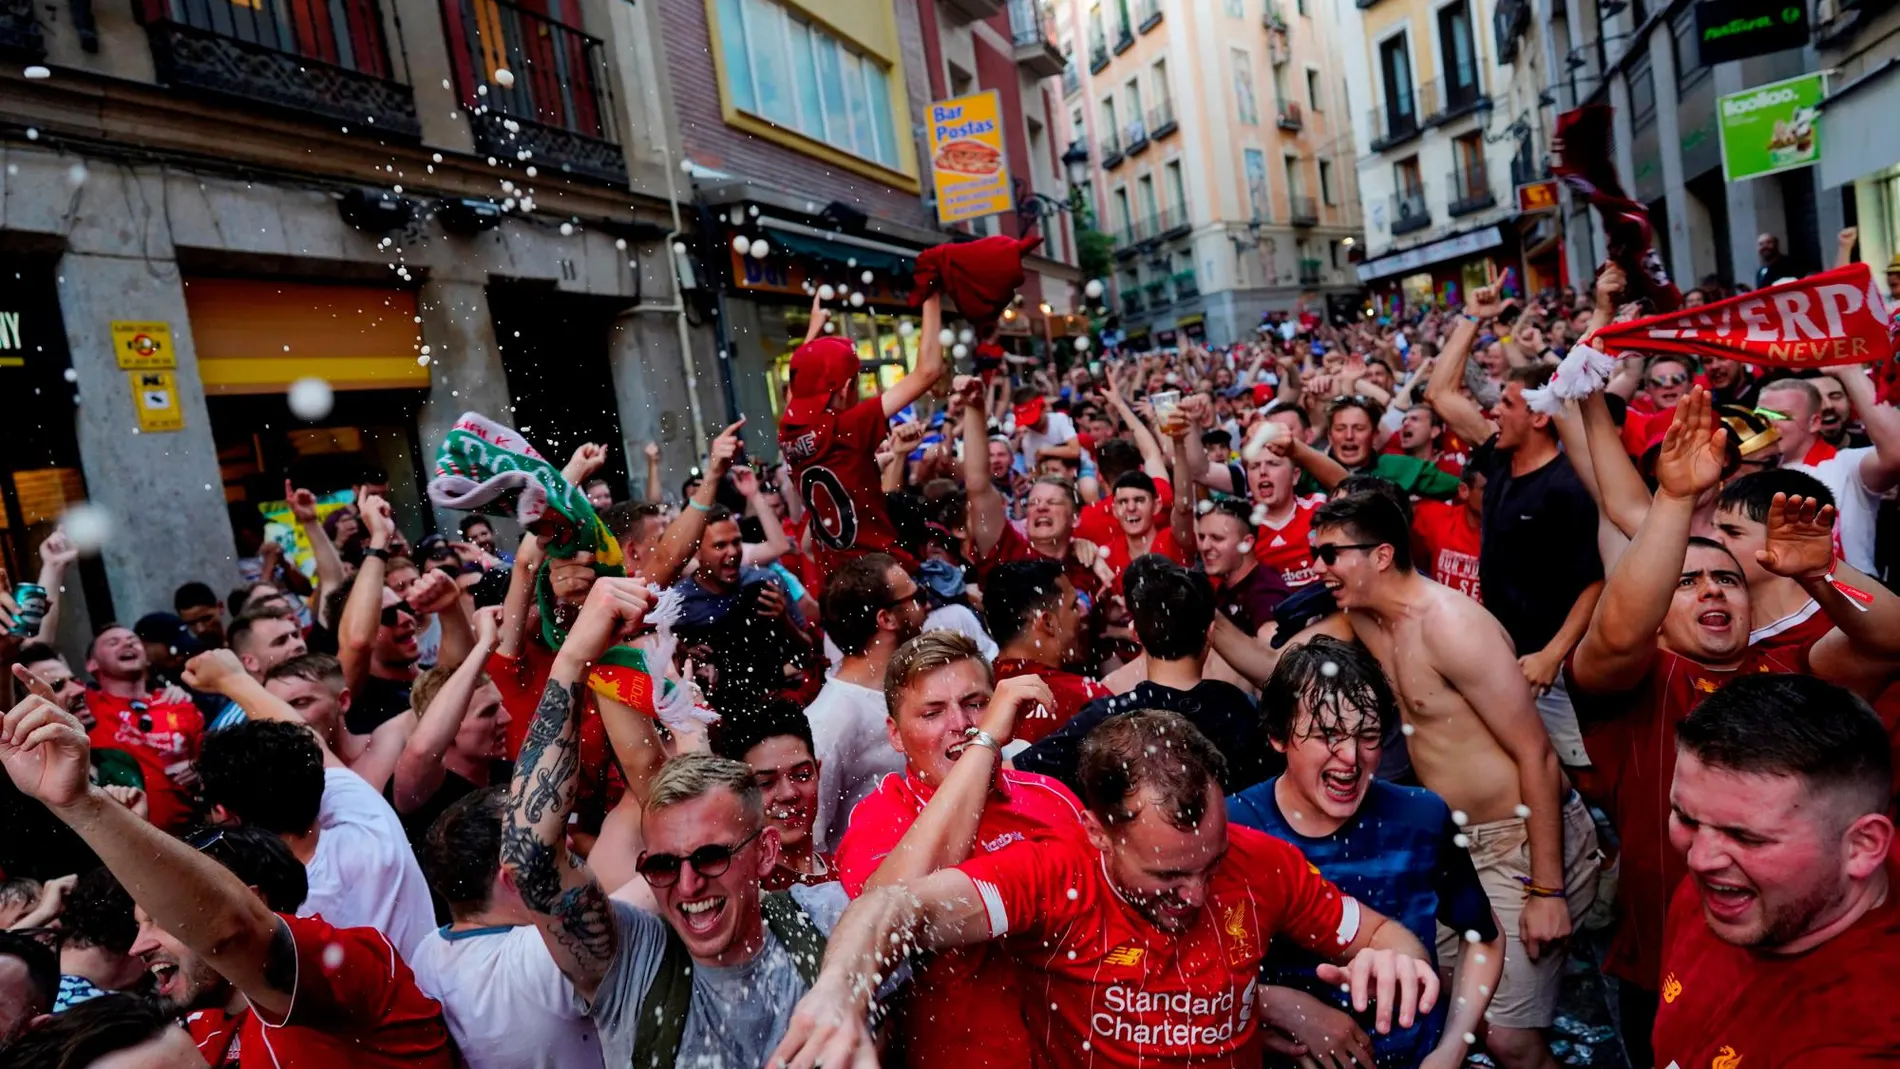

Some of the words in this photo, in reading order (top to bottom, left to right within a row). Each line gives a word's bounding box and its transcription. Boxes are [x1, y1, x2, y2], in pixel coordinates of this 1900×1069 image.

[933, 106, 963, 122] Bar
[935, 119, 994, 141] Postas
[1767, 336, 1870, 362] NEVER
[1104, 985, 1233, 1015] Standard
[1092, 1013, 1232, 1046] Chartered
